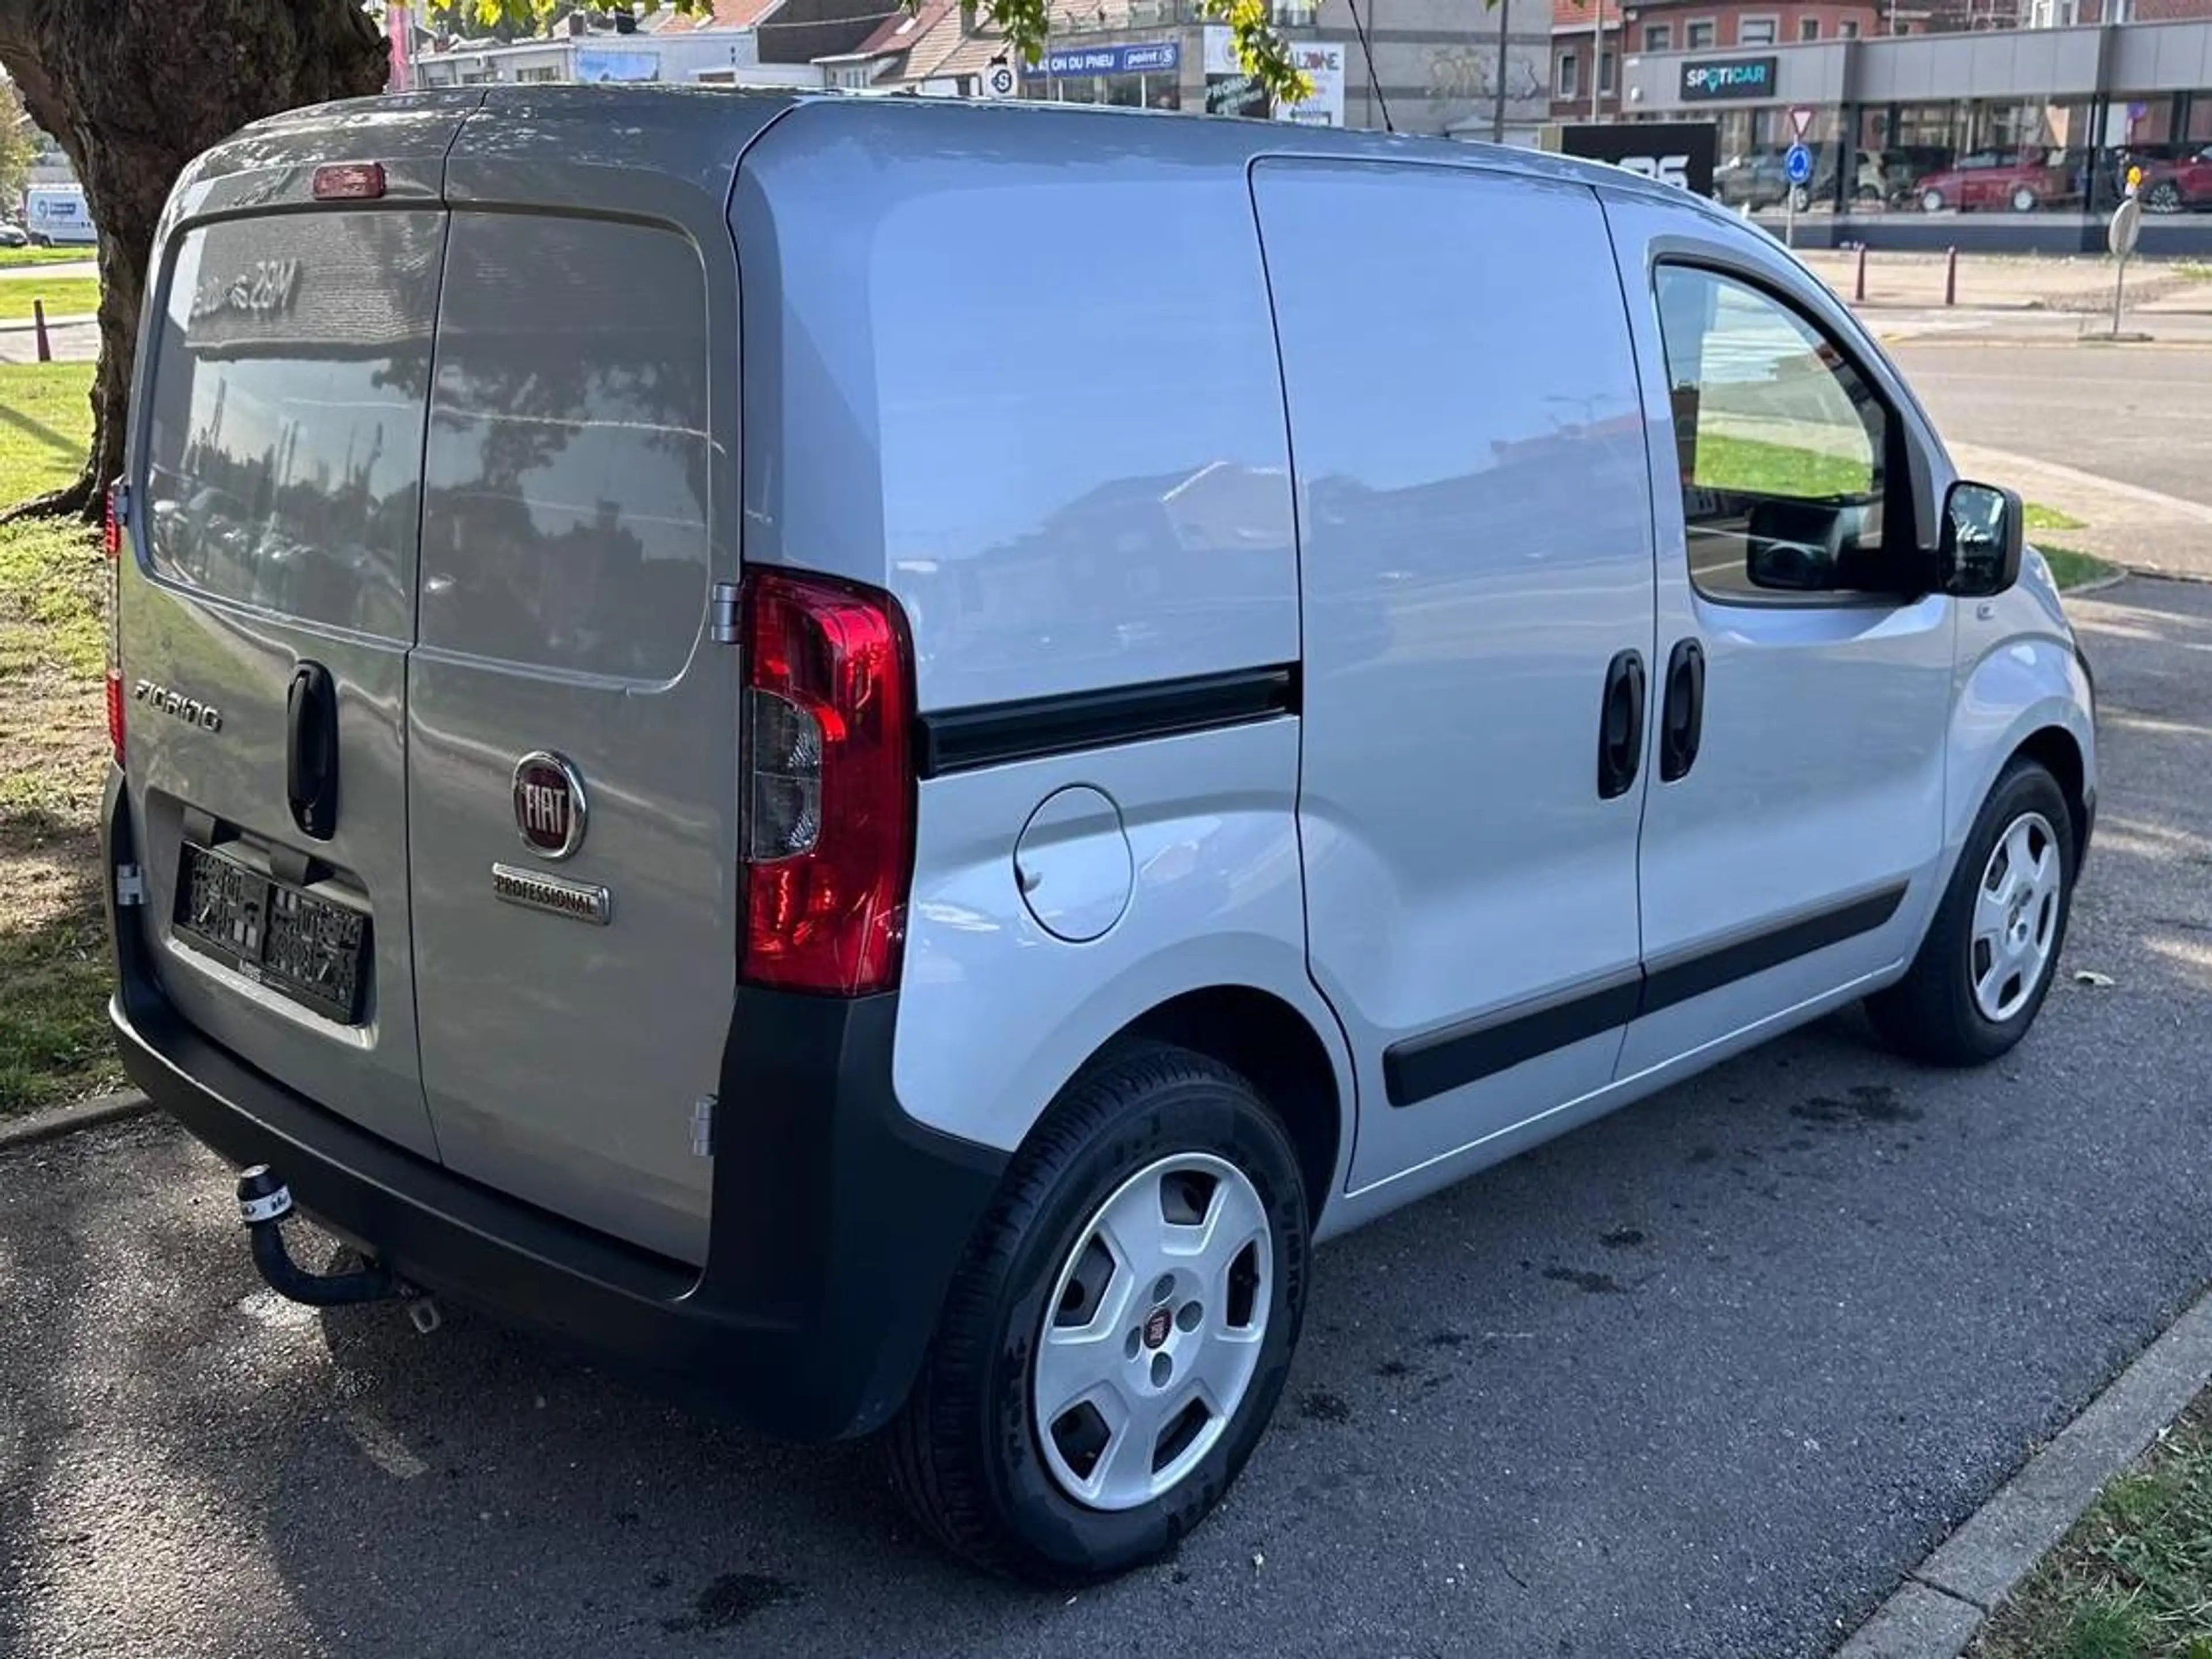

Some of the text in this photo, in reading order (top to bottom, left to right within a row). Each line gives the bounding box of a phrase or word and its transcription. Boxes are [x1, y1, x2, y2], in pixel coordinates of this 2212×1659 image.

[1069, 55, 1084, 70] DU
[1086, 54, 1115, 69] PNEU
[1686, 64, 1766, 92] SPOTICAR
[525, 783, 566, 834] FIAT
[495, 874, 596, 915] PROFESSIONAL
